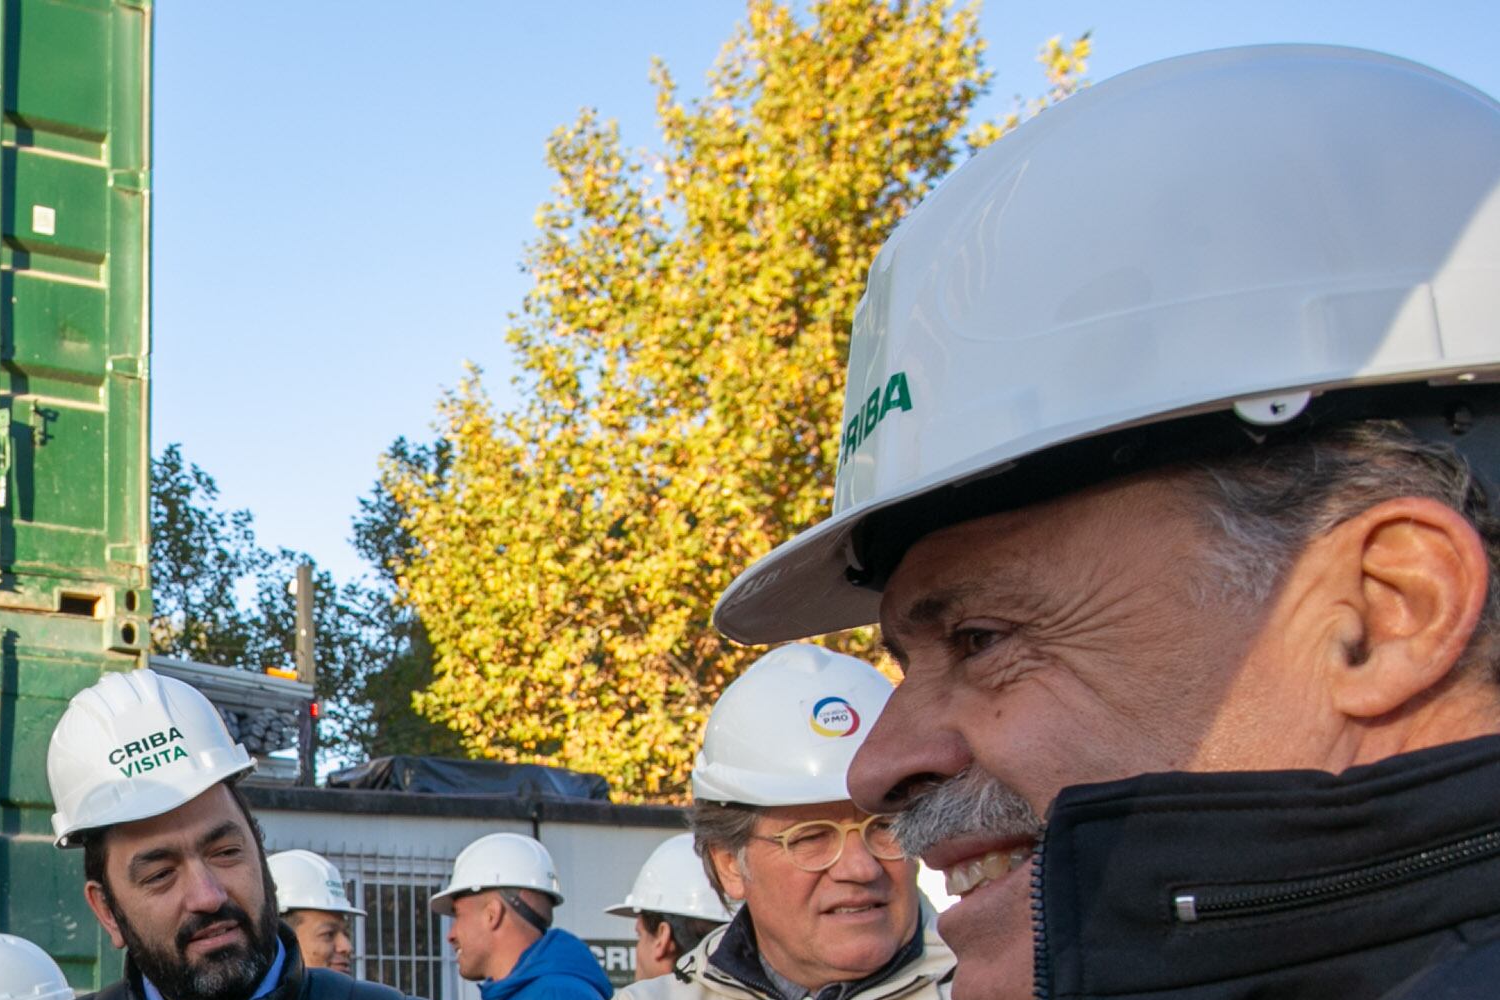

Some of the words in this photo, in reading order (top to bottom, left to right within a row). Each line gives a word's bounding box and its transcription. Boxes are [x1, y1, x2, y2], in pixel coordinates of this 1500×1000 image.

[840, 372, 913, 466] RIBA
[108, 726, 185, 765] CRIBA
[119, 745, 189, 778] VISITA
